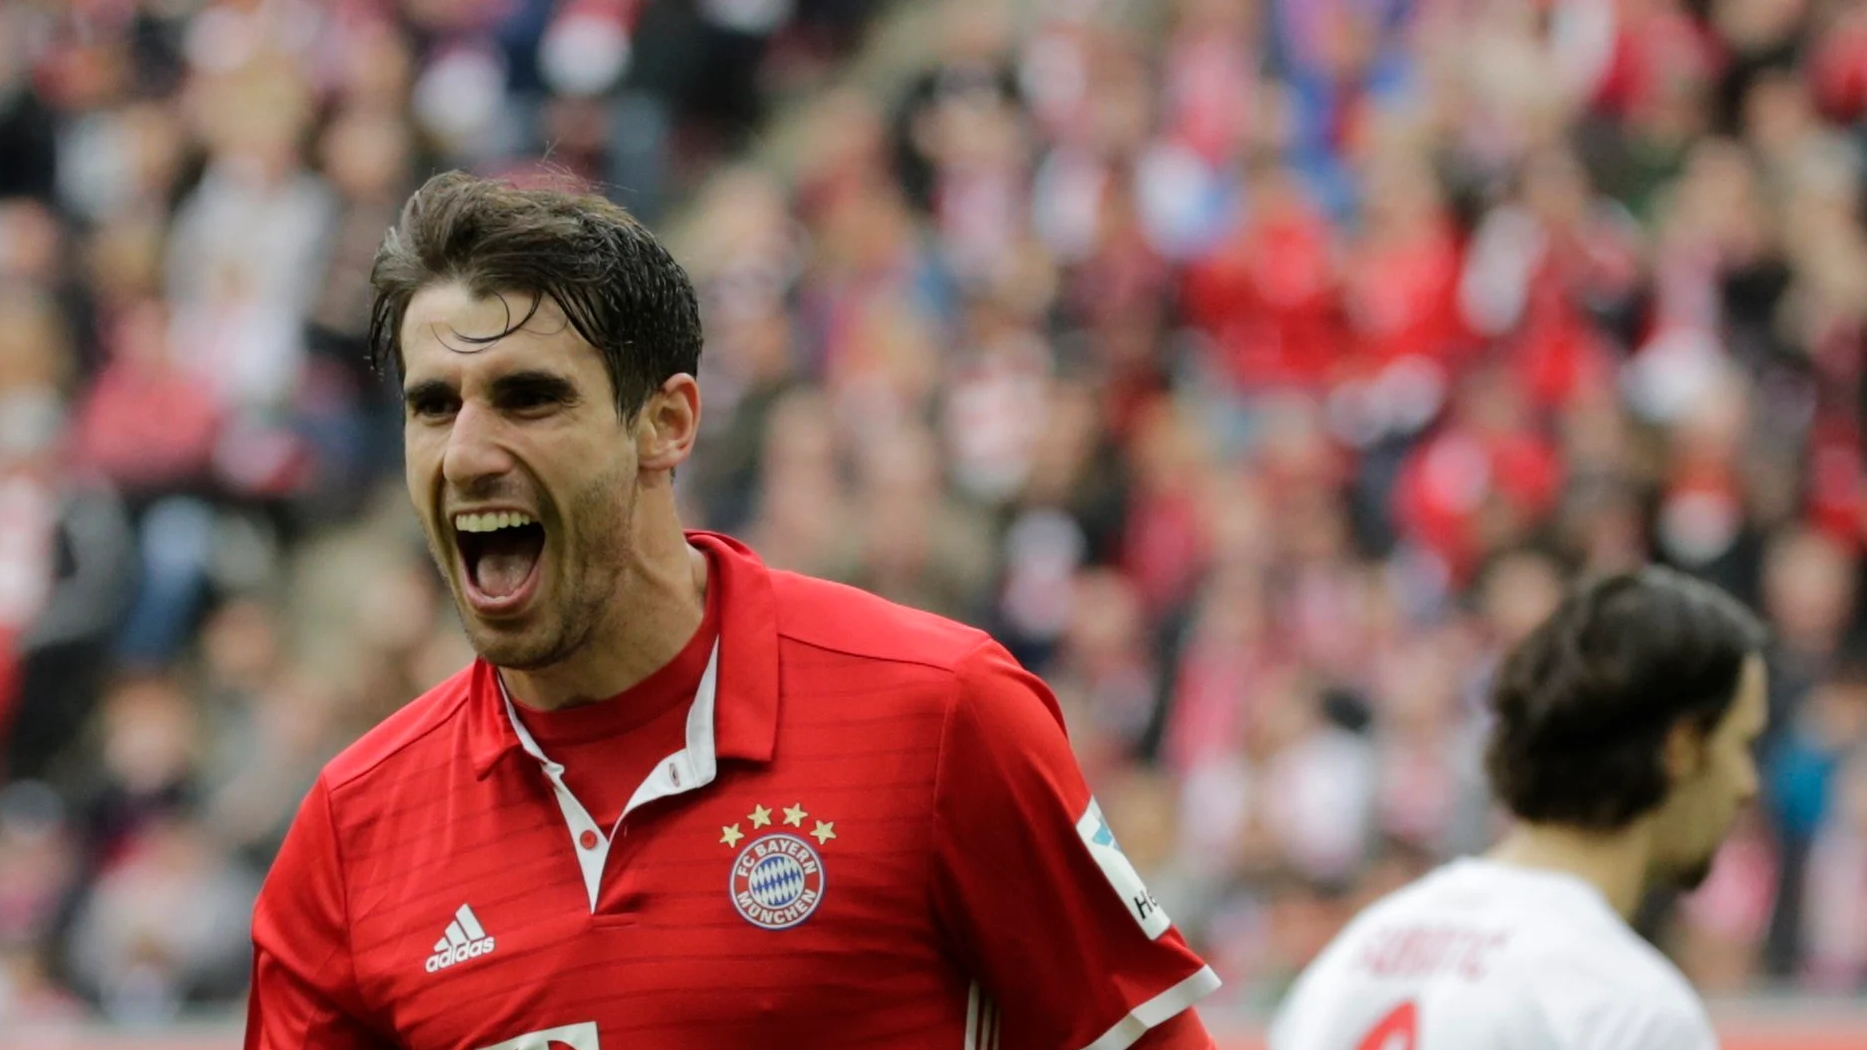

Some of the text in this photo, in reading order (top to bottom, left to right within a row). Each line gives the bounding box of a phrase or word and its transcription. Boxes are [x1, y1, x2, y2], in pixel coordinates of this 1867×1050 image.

[736, 838, 818, 878] FC BAYERN
[736, 888, 818, 925] MÜNCHEN
[425, 936, 496, 974] adidas
